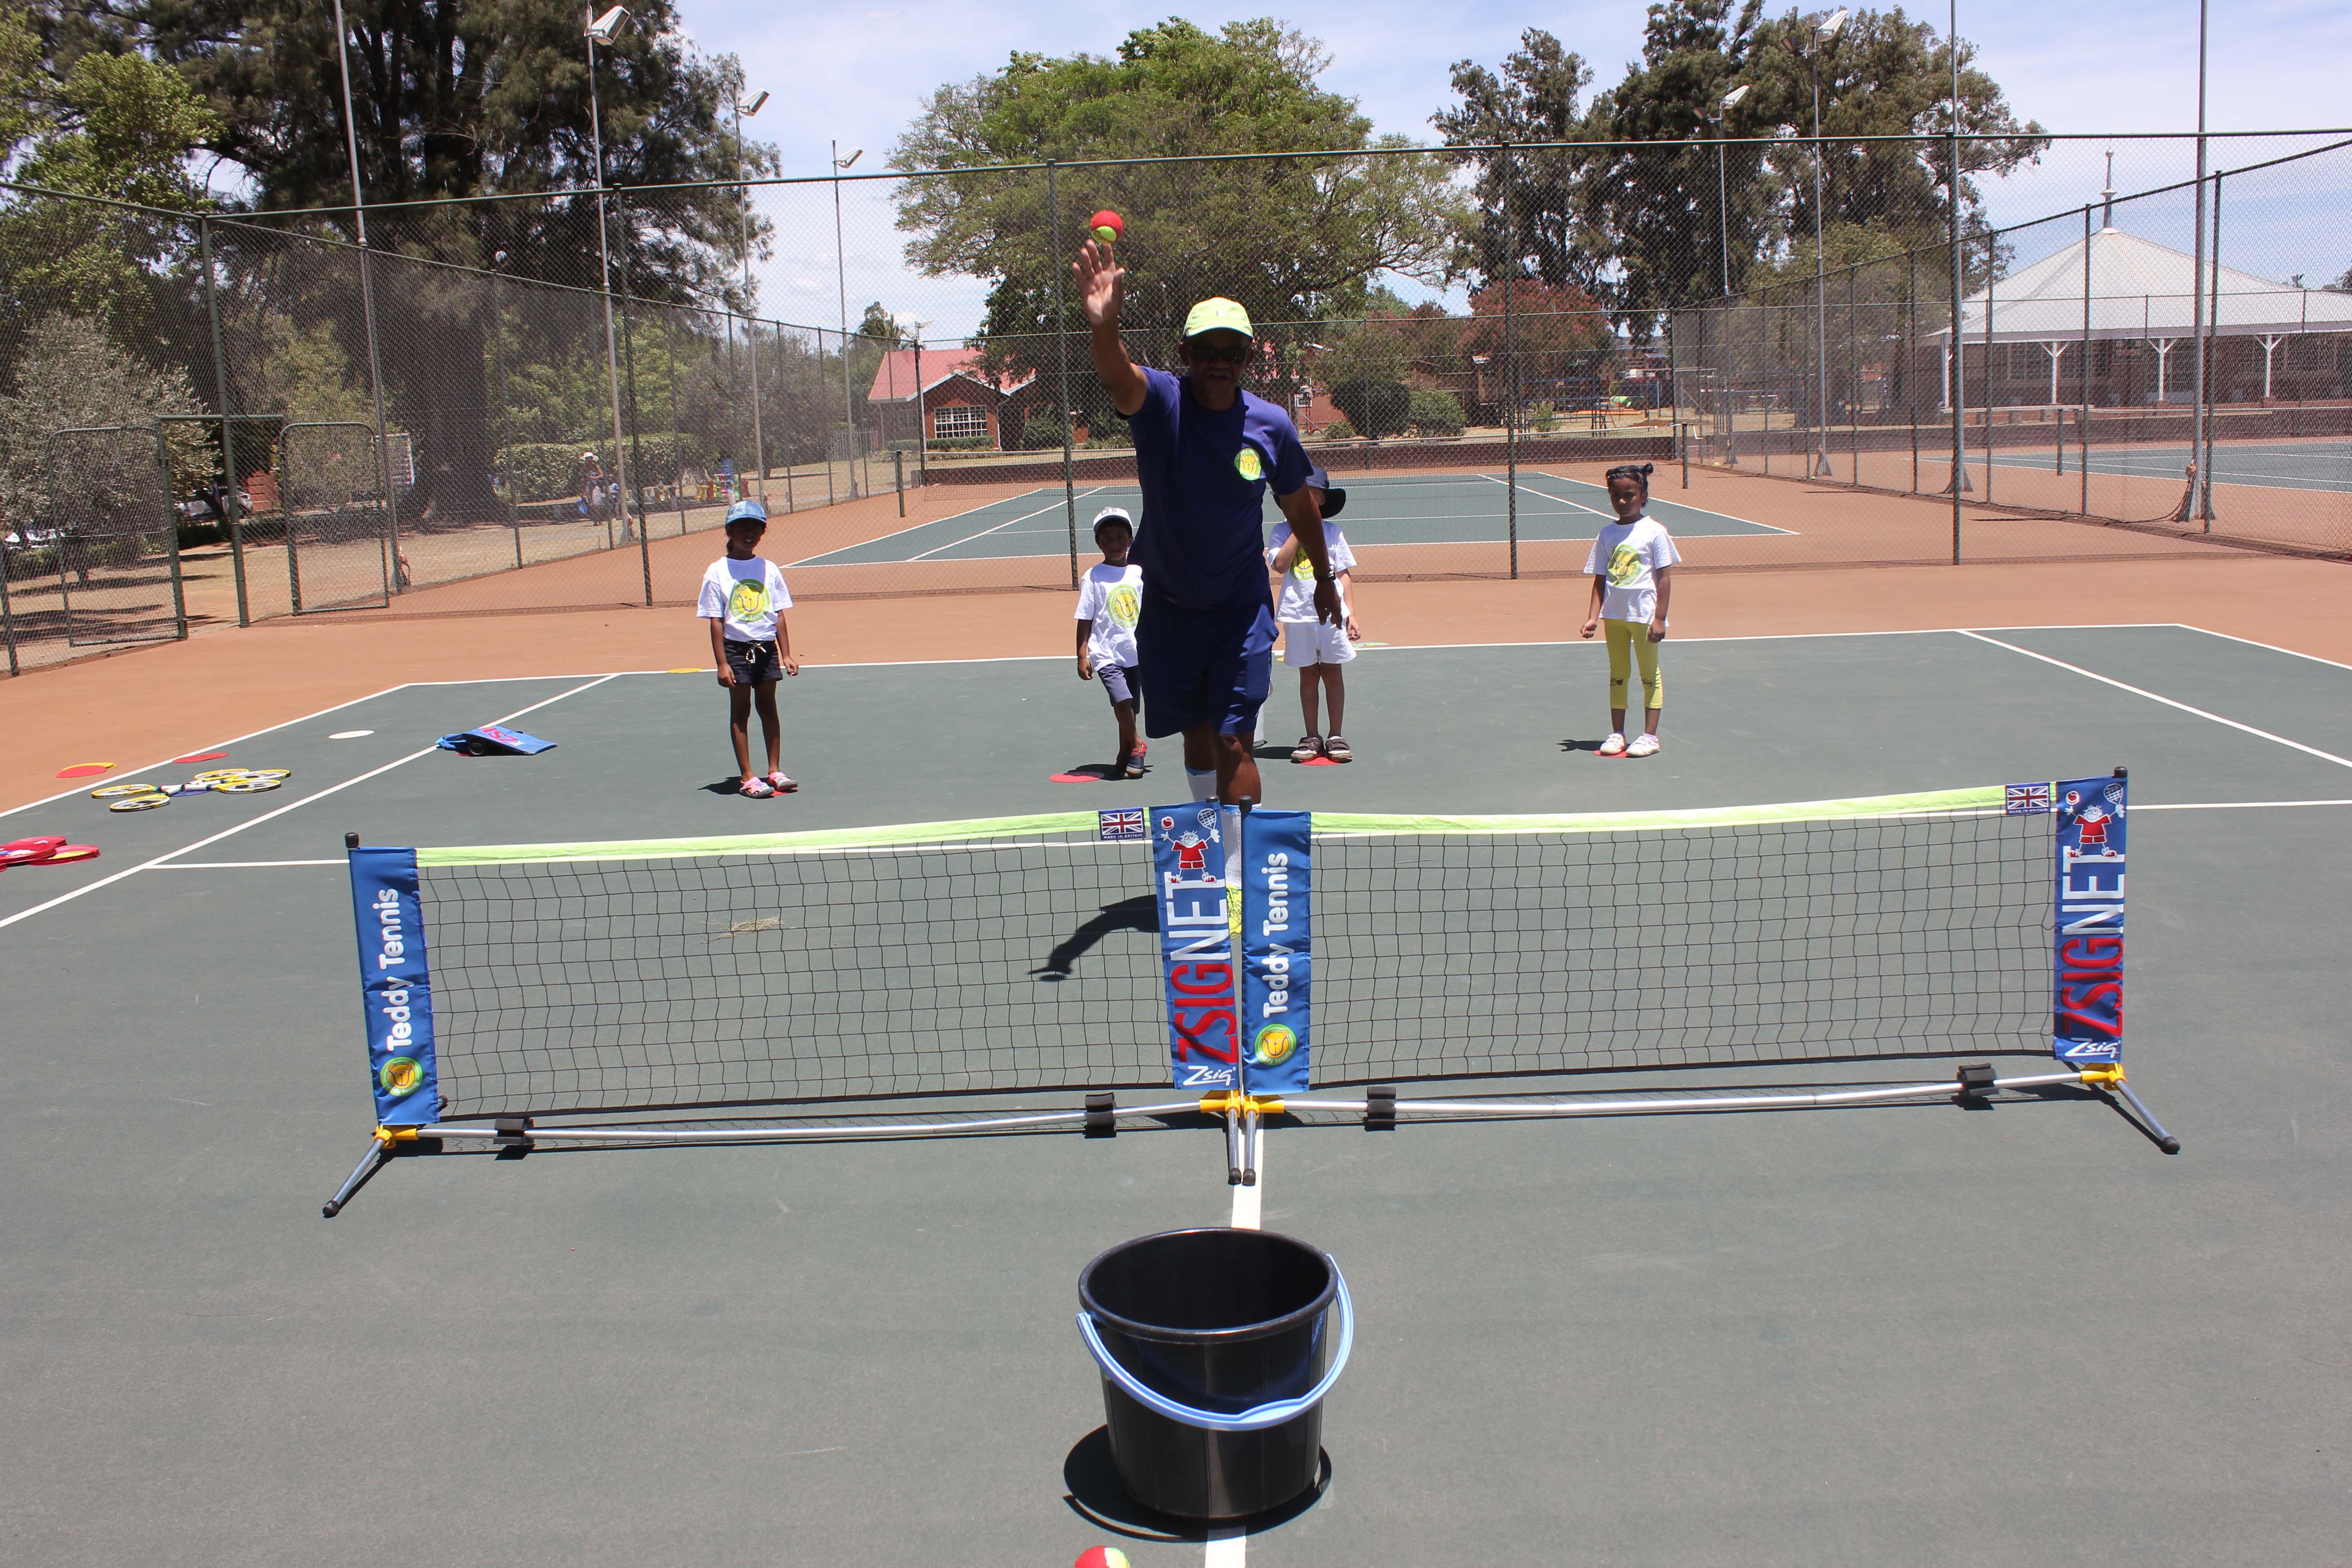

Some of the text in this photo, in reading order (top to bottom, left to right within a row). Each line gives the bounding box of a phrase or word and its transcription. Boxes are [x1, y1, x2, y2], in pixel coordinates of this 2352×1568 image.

[372, 888, 414, 1052] Teddy Tennis
[1164, 871, 1239, 1064] ZSIGNET
[1261, 853, 1294, 1019] Teddy Tennis
[2062, 845, 2125, 1037] ZSIGNET
